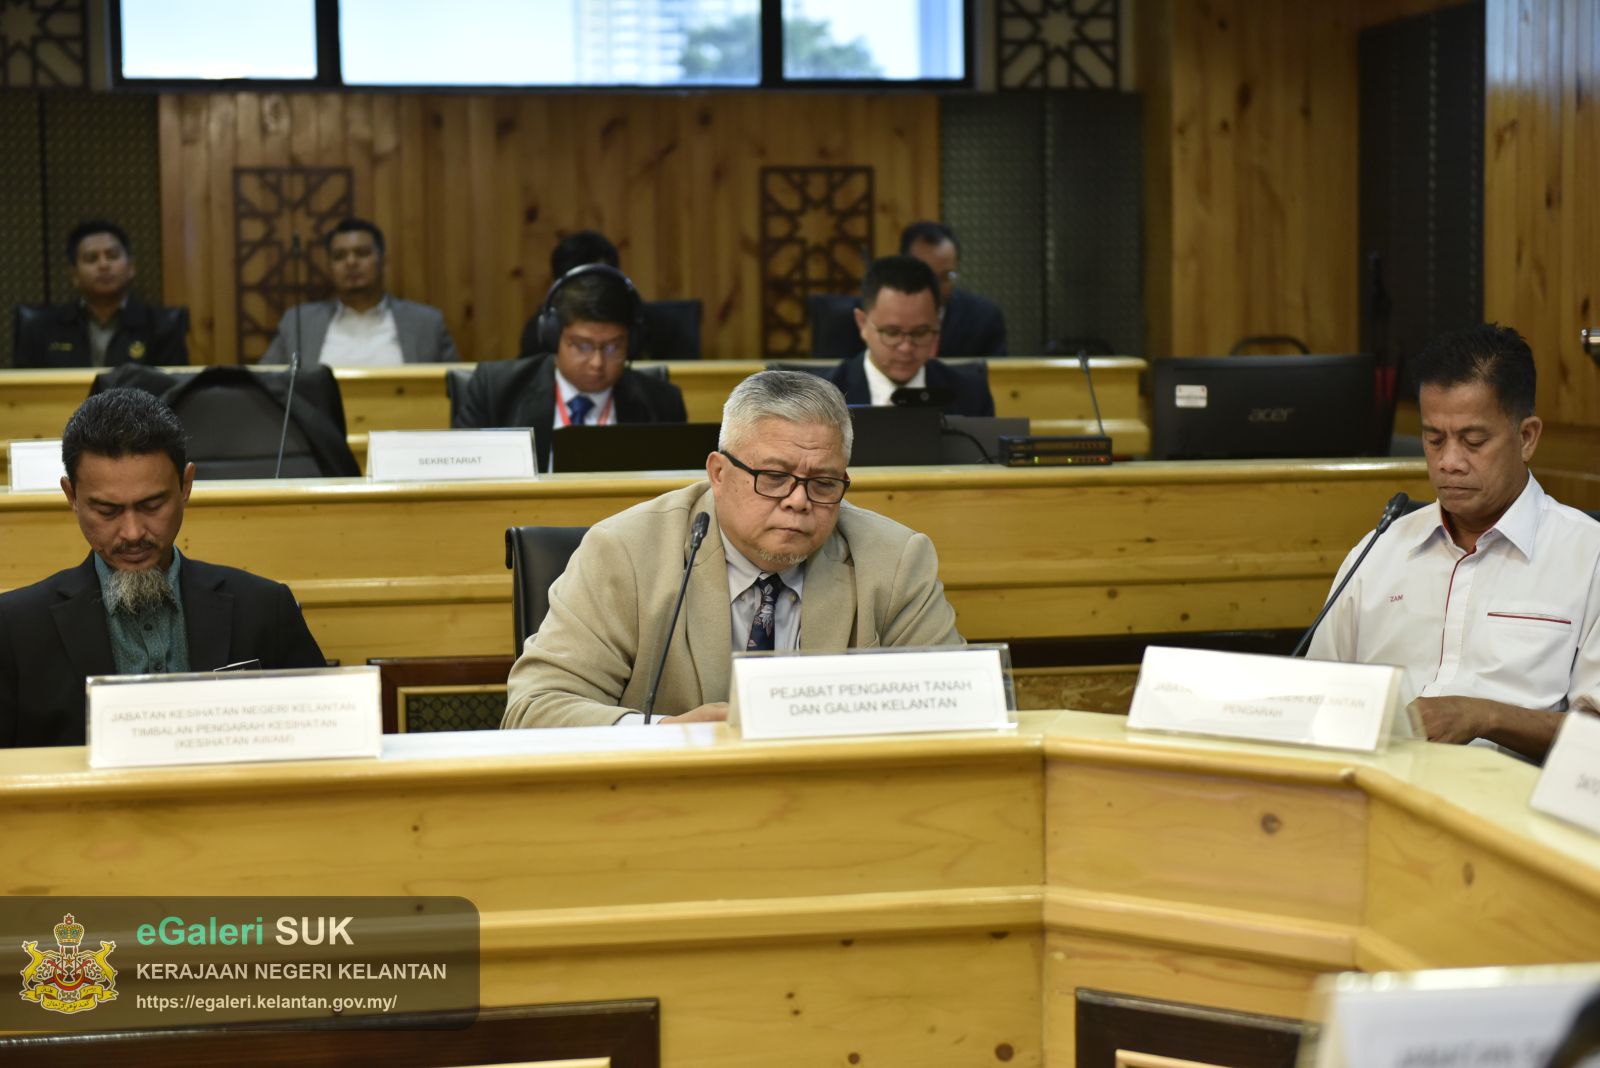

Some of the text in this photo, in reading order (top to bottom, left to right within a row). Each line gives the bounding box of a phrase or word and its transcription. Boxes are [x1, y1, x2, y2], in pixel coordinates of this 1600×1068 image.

[1248, 407, 1296, 422] acer
[418, 456, 482, 465] SEKRETARIAT
[770, 680, 972, 699] PEJABAT PENGARAH TANAH
[110, 701, 357, 722] JABATAN KESIHATAN NEGERI KELANTAN
[790, 697, 958, 716] DAN GALIAN KELANTAN
[1222, 704, 1283, 718] PENGARAH
[131, 718, 338, 737] TIMBALAN PENGARAH KESIHATAN
[174, 736, 249, 750] (KESIHATAN
